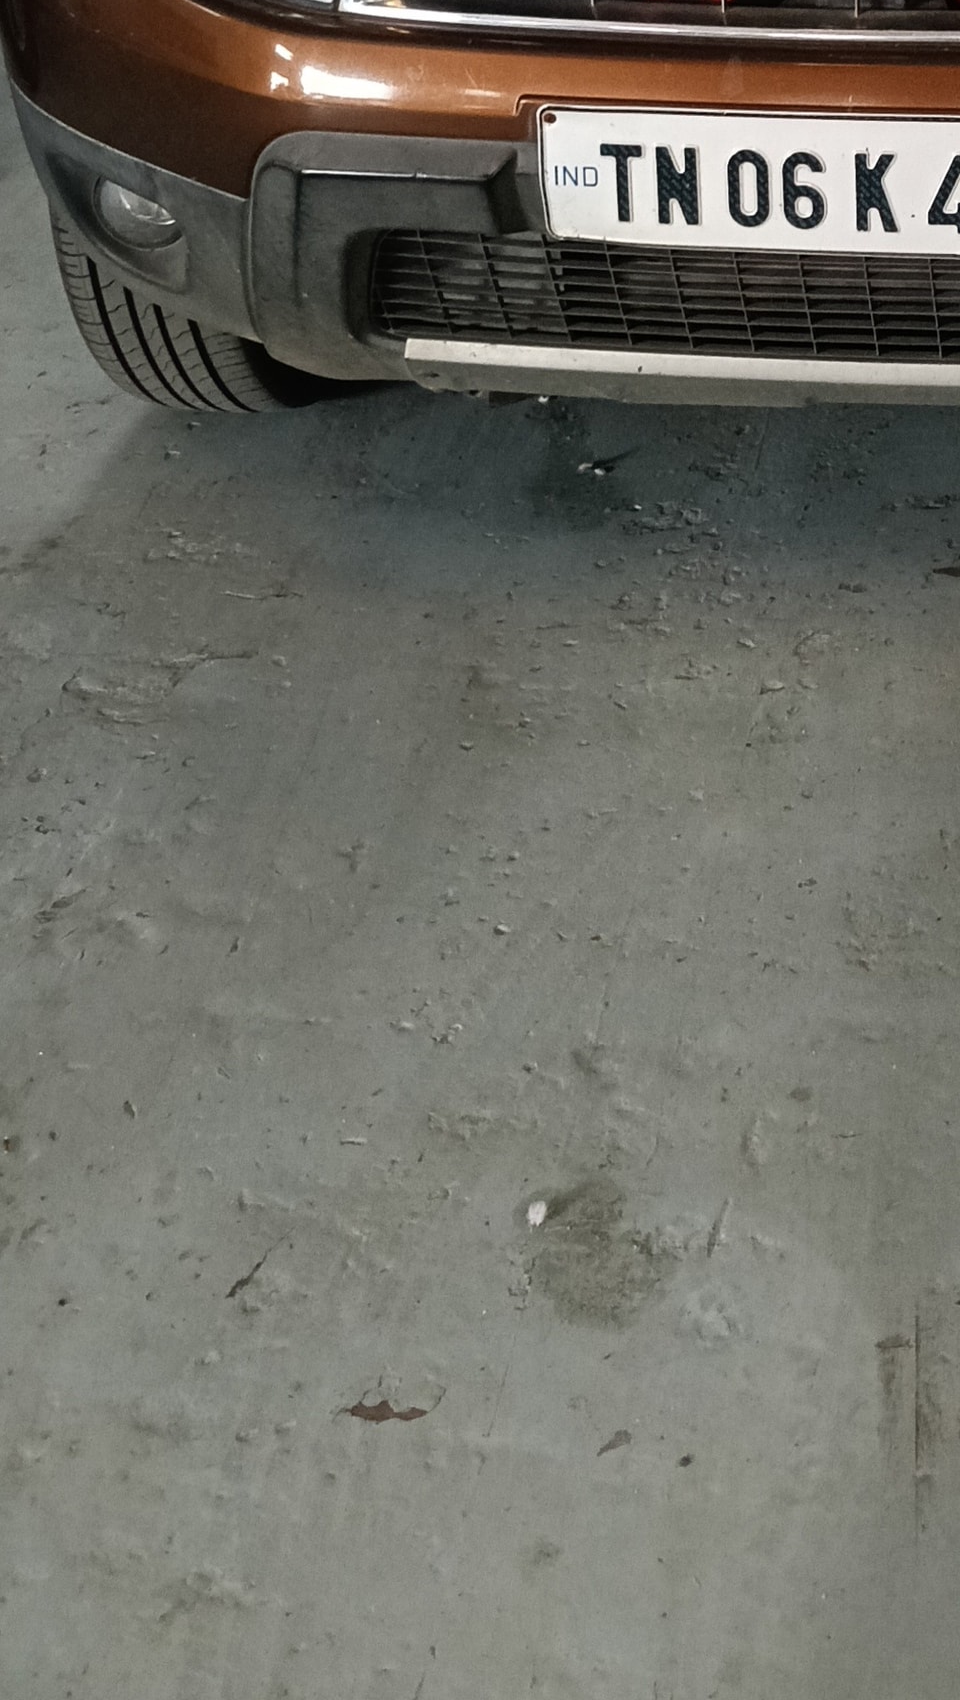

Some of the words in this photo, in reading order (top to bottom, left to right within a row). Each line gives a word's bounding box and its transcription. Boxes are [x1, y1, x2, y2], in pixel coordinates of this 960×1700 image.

[554, 165, 598, 187] IND
[600, 143, 701, 226] TN
[727, 149, 826, 230] 06
[855, 152, 900, 233] K
